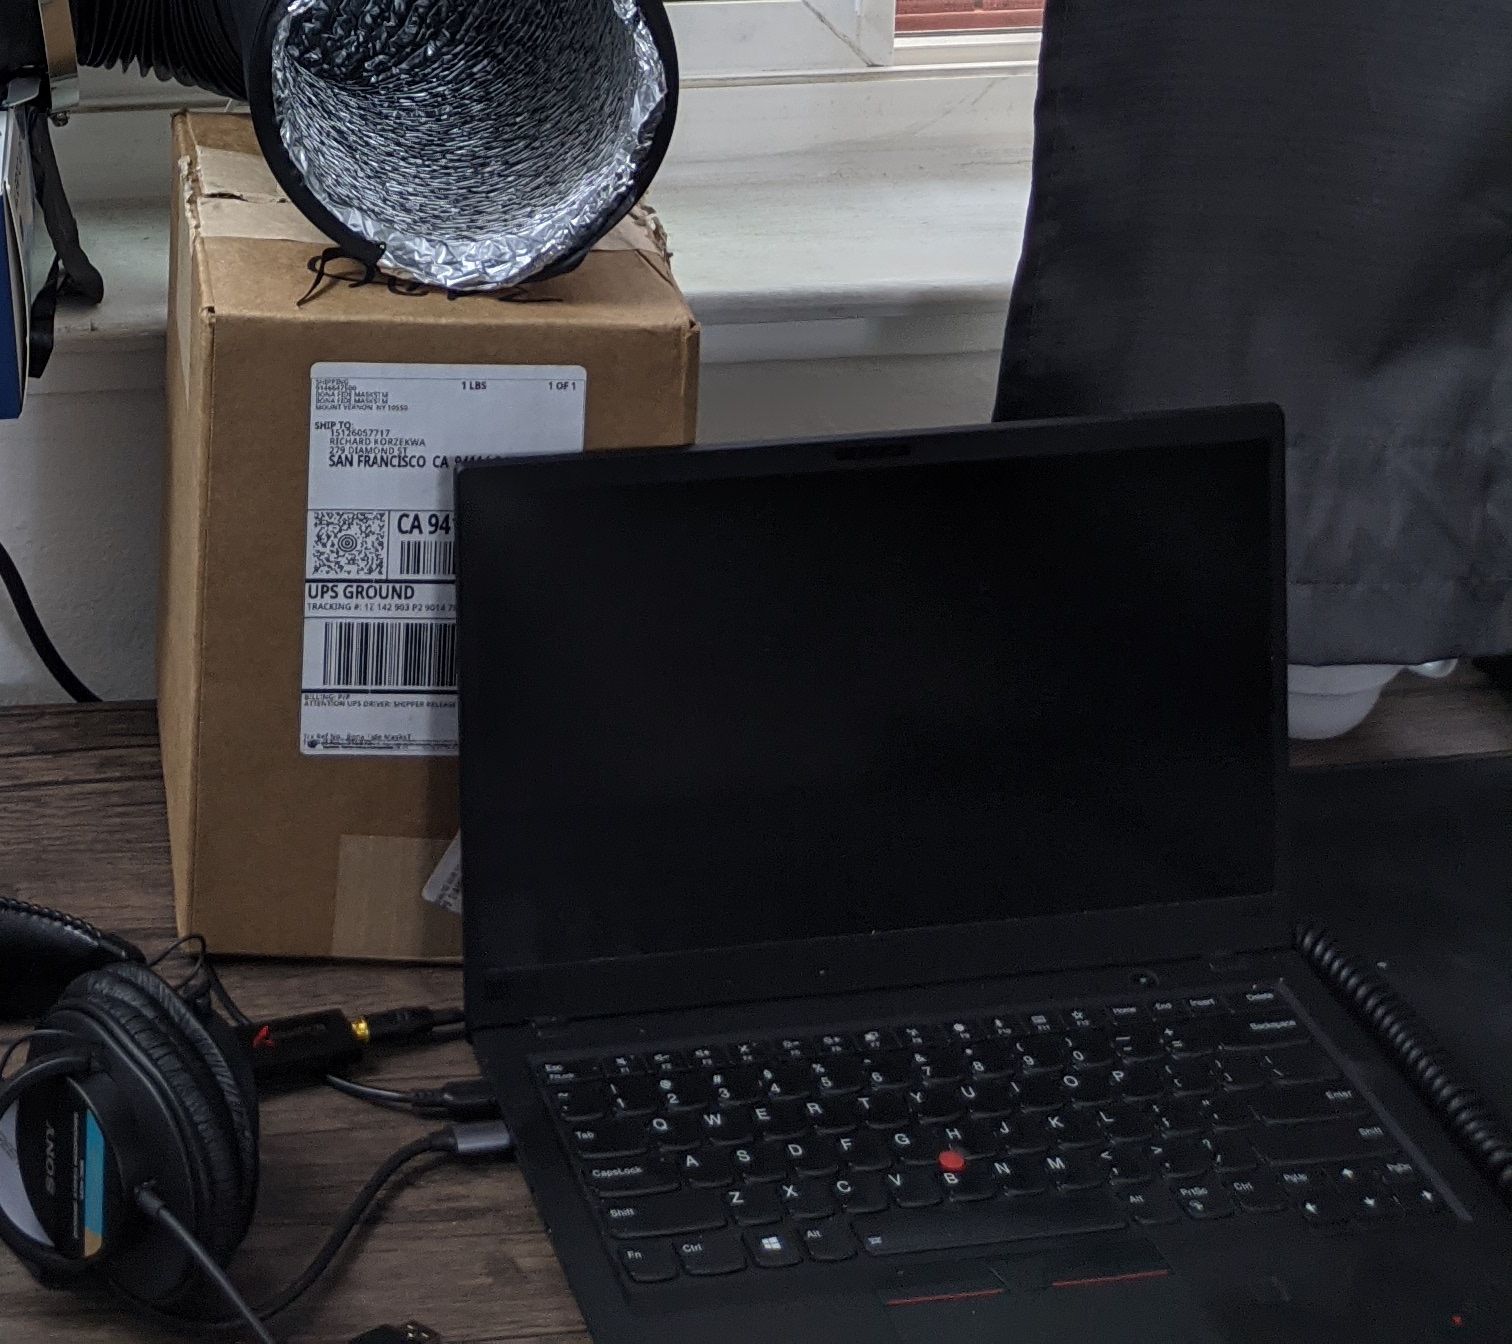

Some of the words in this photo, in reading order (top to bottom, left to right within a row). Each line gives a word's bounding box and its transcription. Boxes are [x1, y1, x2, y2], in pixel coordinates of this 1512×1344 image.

[469, 381, 487, 389] LBS
[315, 422, 336, 430] SHIP
[329, 438, 371, 446] RICHARD
[374, 438, 426, 446] KORZEKWA
[329, 446, 345, 454] 279
[348, 446, 395, 455] DIAMOND
[397, 447, 407, 455] ST
[329, 455, 354, 467] SAN
[357, 456, 426, 467] FRANCISCO
[432, 456, 449, 467] CA
[397, 513, 423, 535] CA
[428, 513, 455, 535] 94
[308, 585, 338, 599] UPS
[343, 585, 414, 599] GROUND
[1063, 1076, 1079, 1087] O
[910, 1091, 923, 1103] Y
[961, 1087, 975, 1098] U
[806, 1103, 823, 1114] R
[858, 1097, 870, 1109] T
[704, 1114, 721, 1125] W
[756, 1108, 770, 1121] E
[653, 1118, 668, 1131] Q
[999, 1121, 1010, 1134] J
[1048, 1116, 1064, 1128] K
[576, 1131, 594, 1139] Tab
[894, 1134, 911, 1145] G
[946, 1128, 962, 1140] H
[788, 1144, 802, 1155] D
[840, 1138, 852, 1149] F
[46, 1119, 55, 1195] SONY
[686, 1155, 699, 1167] A
[737, 1150, 750, 1162] S
[994, 1163, 1011, 1174] N
[1047, 1157, 1065, 1169] M
[593, 1166, 642, 1177] CapsLock
[888, 1174, 902, 1186] V
[944, 1172, 959, 1184] B
[783, 1186, 798, 1198] X
[837, 1181, 852, 1193] C
[729, 1192, 744, 1204] Z
[610, 1208, 635, 1218] Shift
[807, 1230, 821, 1238] Alt
[682, 1244, 703, 1252] Ctrl
[627, 1250, 642, 1260] Fn
